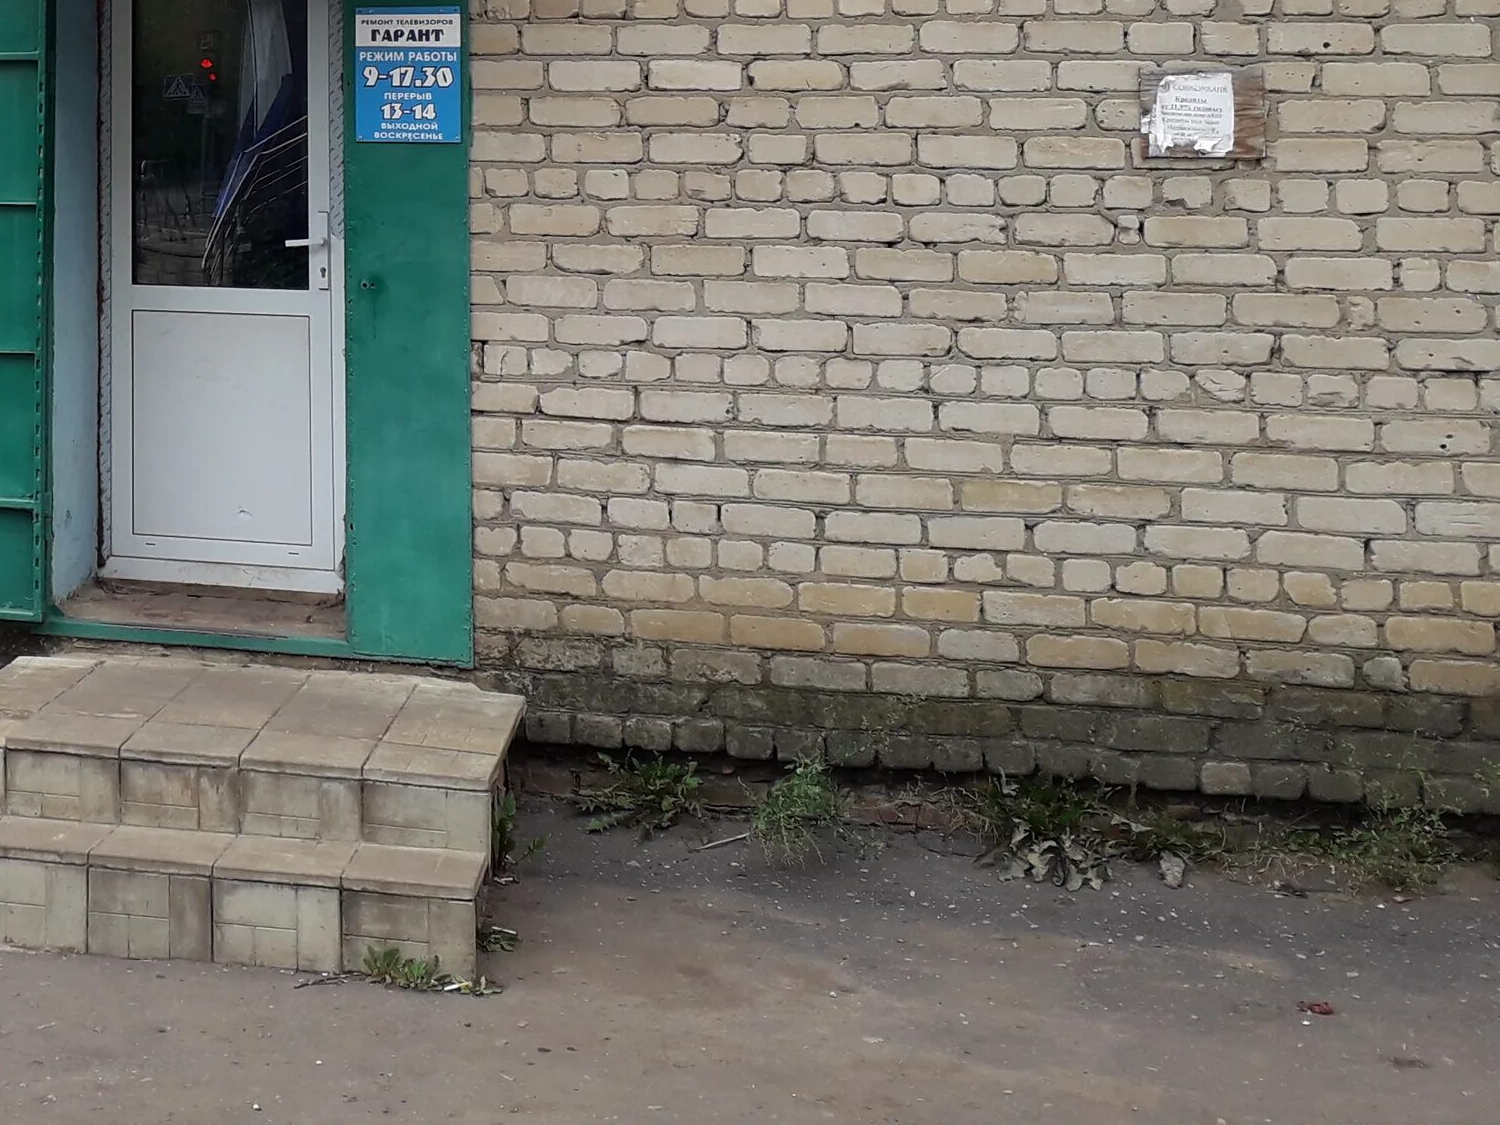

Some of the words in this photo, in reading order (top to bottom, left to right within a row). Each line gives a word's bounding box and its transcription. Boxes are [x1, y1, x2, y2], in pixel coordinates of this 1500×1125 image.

[371, 29, 444, 42] ГАРАНТ
[359, 52, 404, 62] РЕЖИМ
[408, 51, 457, 62] РАБОТЫ
[362, 66, 454, 88] 9-17.30
[384, 92, 432, 100] ПЕРЕРЫВ
[380, 103, 436, 120] 13-14
[381, 122, 438, 130] ВЫХОДНОЙ
[374, 132, 443, 140] ВОСКРЕСЕНЬЕ
